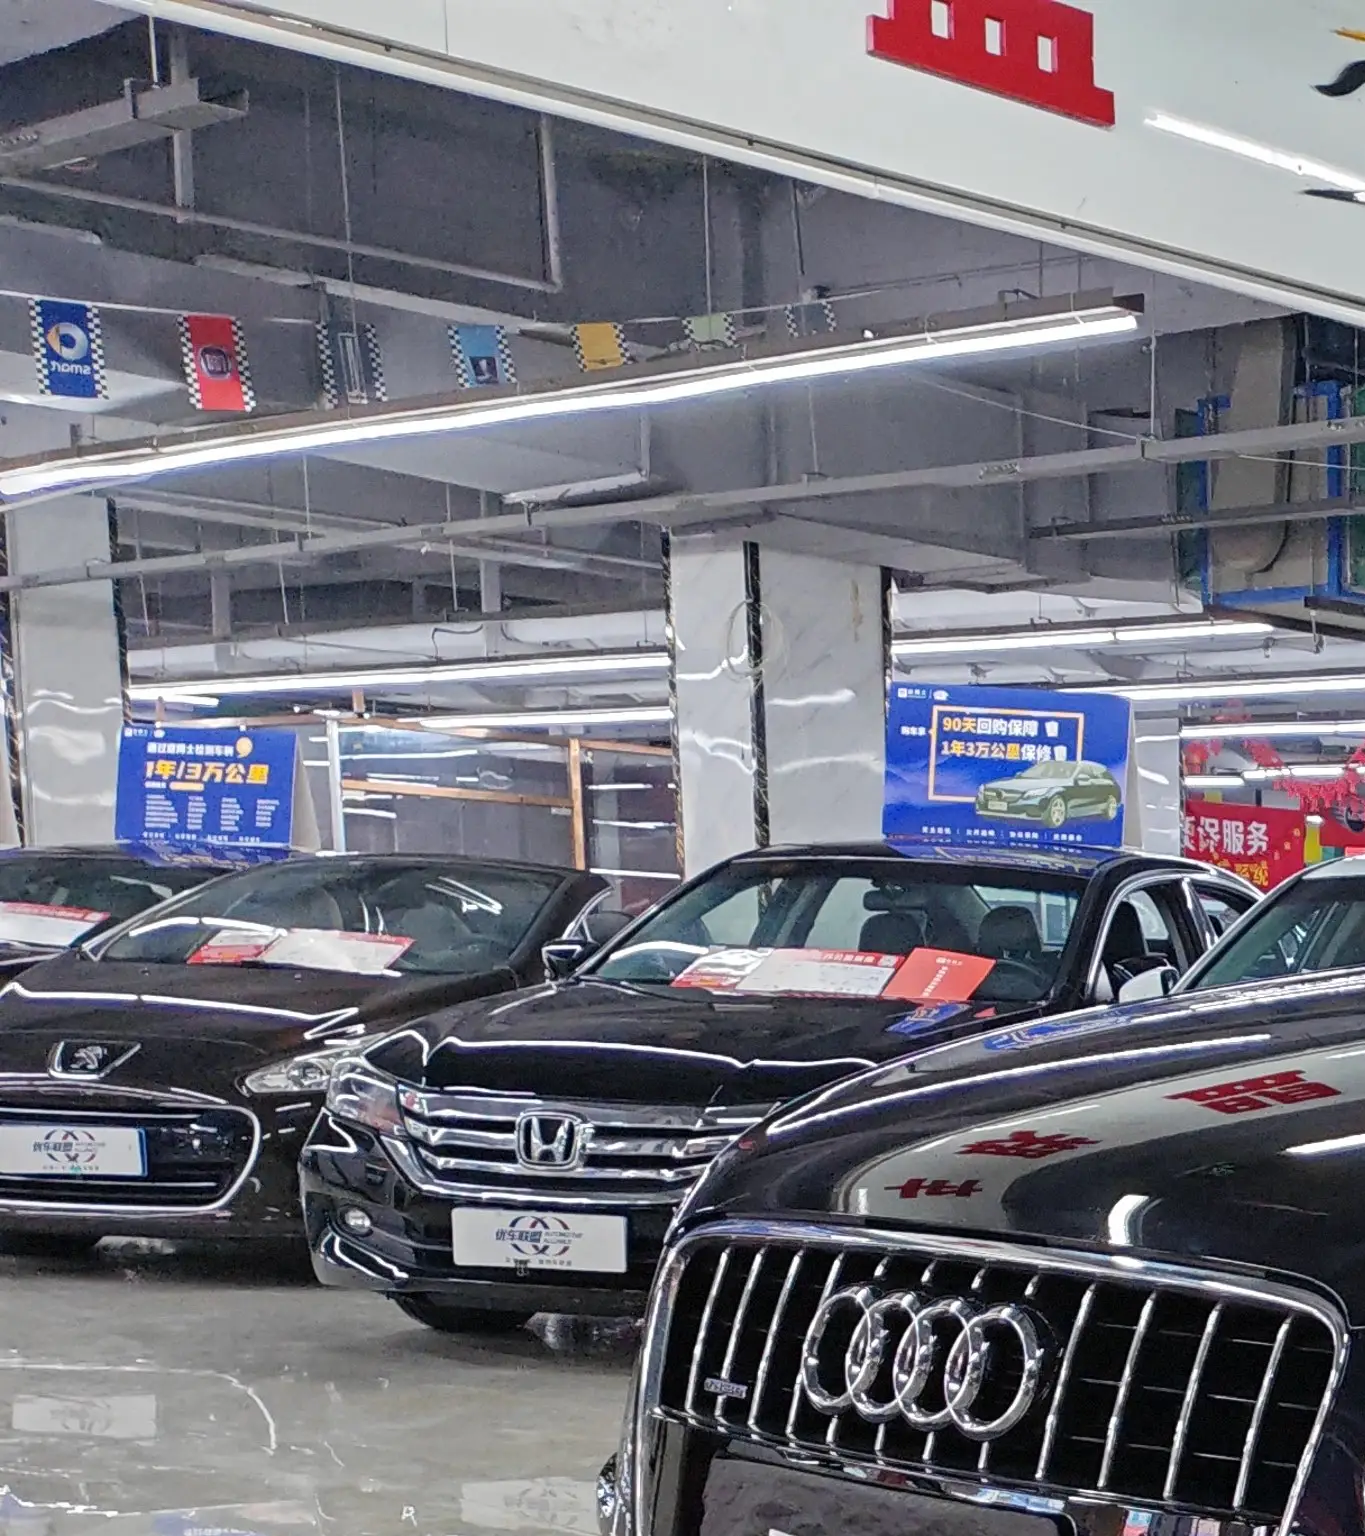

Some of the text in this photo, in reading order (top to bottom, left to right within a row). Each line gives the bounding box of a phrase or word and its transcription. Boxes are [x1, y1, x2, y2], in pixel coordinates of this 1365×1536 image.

[942, 716, 1039, 737] 90天回购保障
[941, 740, 1054, 761] 1年3万公里保修
